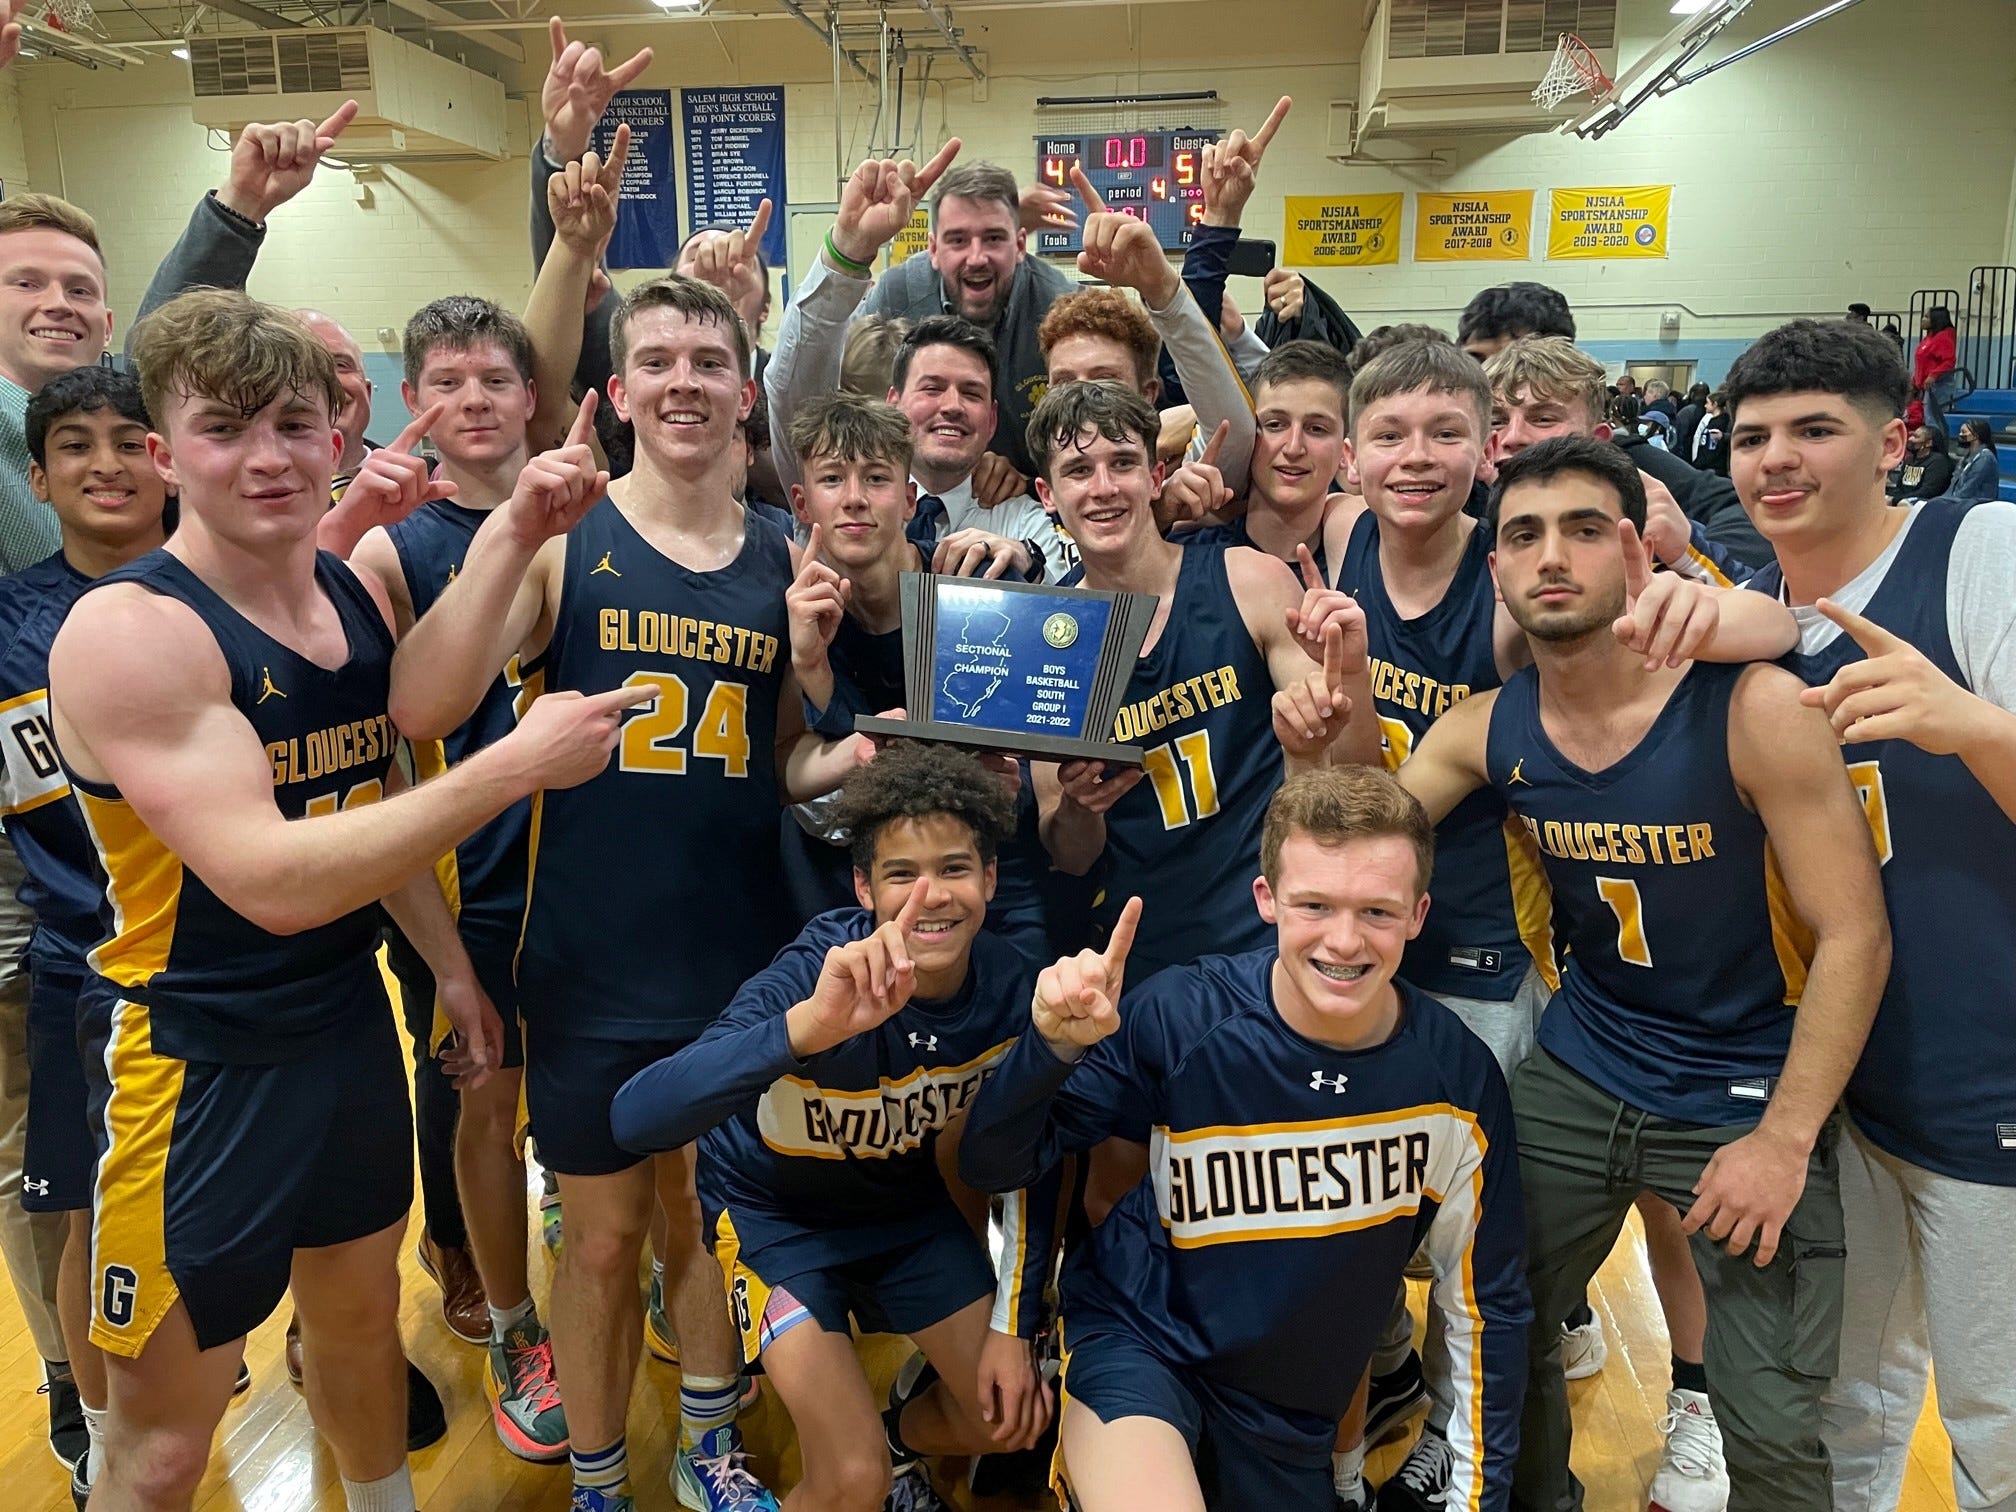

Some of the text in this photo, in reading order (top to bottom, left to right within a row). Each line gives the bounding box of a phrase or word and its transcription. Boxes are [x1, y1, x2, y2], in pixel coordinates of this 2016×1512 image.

[610, 97, 665, 106] HIGH SCHOOL
[687, 92, 778, 103] SALEM HIGH SCHOOL
[617, 107, 670, 116] BASKETBALL
[694, 103, 772, 113] MEN'S BASKETBALL
[602, 117, 625, 126] POINT
[627, 117, 665, 126] SCORERS
[710, 114, 735, 123] POINT
[738, 113, 776, 122] SCORERS
[1047, 141, 1075, 154] Home
[1105, 136, 1146, 168] 0.0
[1108, 186, 1142, 201] period
[1452, 202, 1489, 212] NJSIAA
[1586, 196, 1625, 207] NJSIAA
[1321, 206, 1360, 218] NJSIAA
[1560, 209, 1649, 221] SPORTSMANSHIP
[1297, 218, 1382, 231] SPORTSMANSHIP
[1429, 213, 1511, 225] SPORTSMANSHIP
[1451, 226, 1488, 237] AWARD
[1584, 222, 1623, 234] AWARD
[1044, 235, 1068, 246] fouls
[1321, 232, 1357, 244] AWARD
[1444, 238, 1492, 249] 2017-2018
[1313, 245, 1363, 255] 2006-2007
[599, 608, 779, 674] GLOUCESTER
[955, 644, 1012, 657] SECTIONAL
[954, 663, 1009, 676] CHAMPION
[1043, 664, 1066, 675] BOYS
[1026, 675, 1080, 689] BASKETBALL
[1036, 689, 1065, 700] SOUTH
[1032, 701, 1061, 712] GROUP
[1110, 664, 1243, 743] OUCESTER
[619, 670, 751, 778] 24
[1026, 713, 1070, 727] 2021-2022
[265, 714, 398, 786] GLOUCESTE
[1485, 955, 1493, 965] S
[1169, 1132, 1430, 1223] GLOUCESTER
[102, 1262, 139, 1328] G
